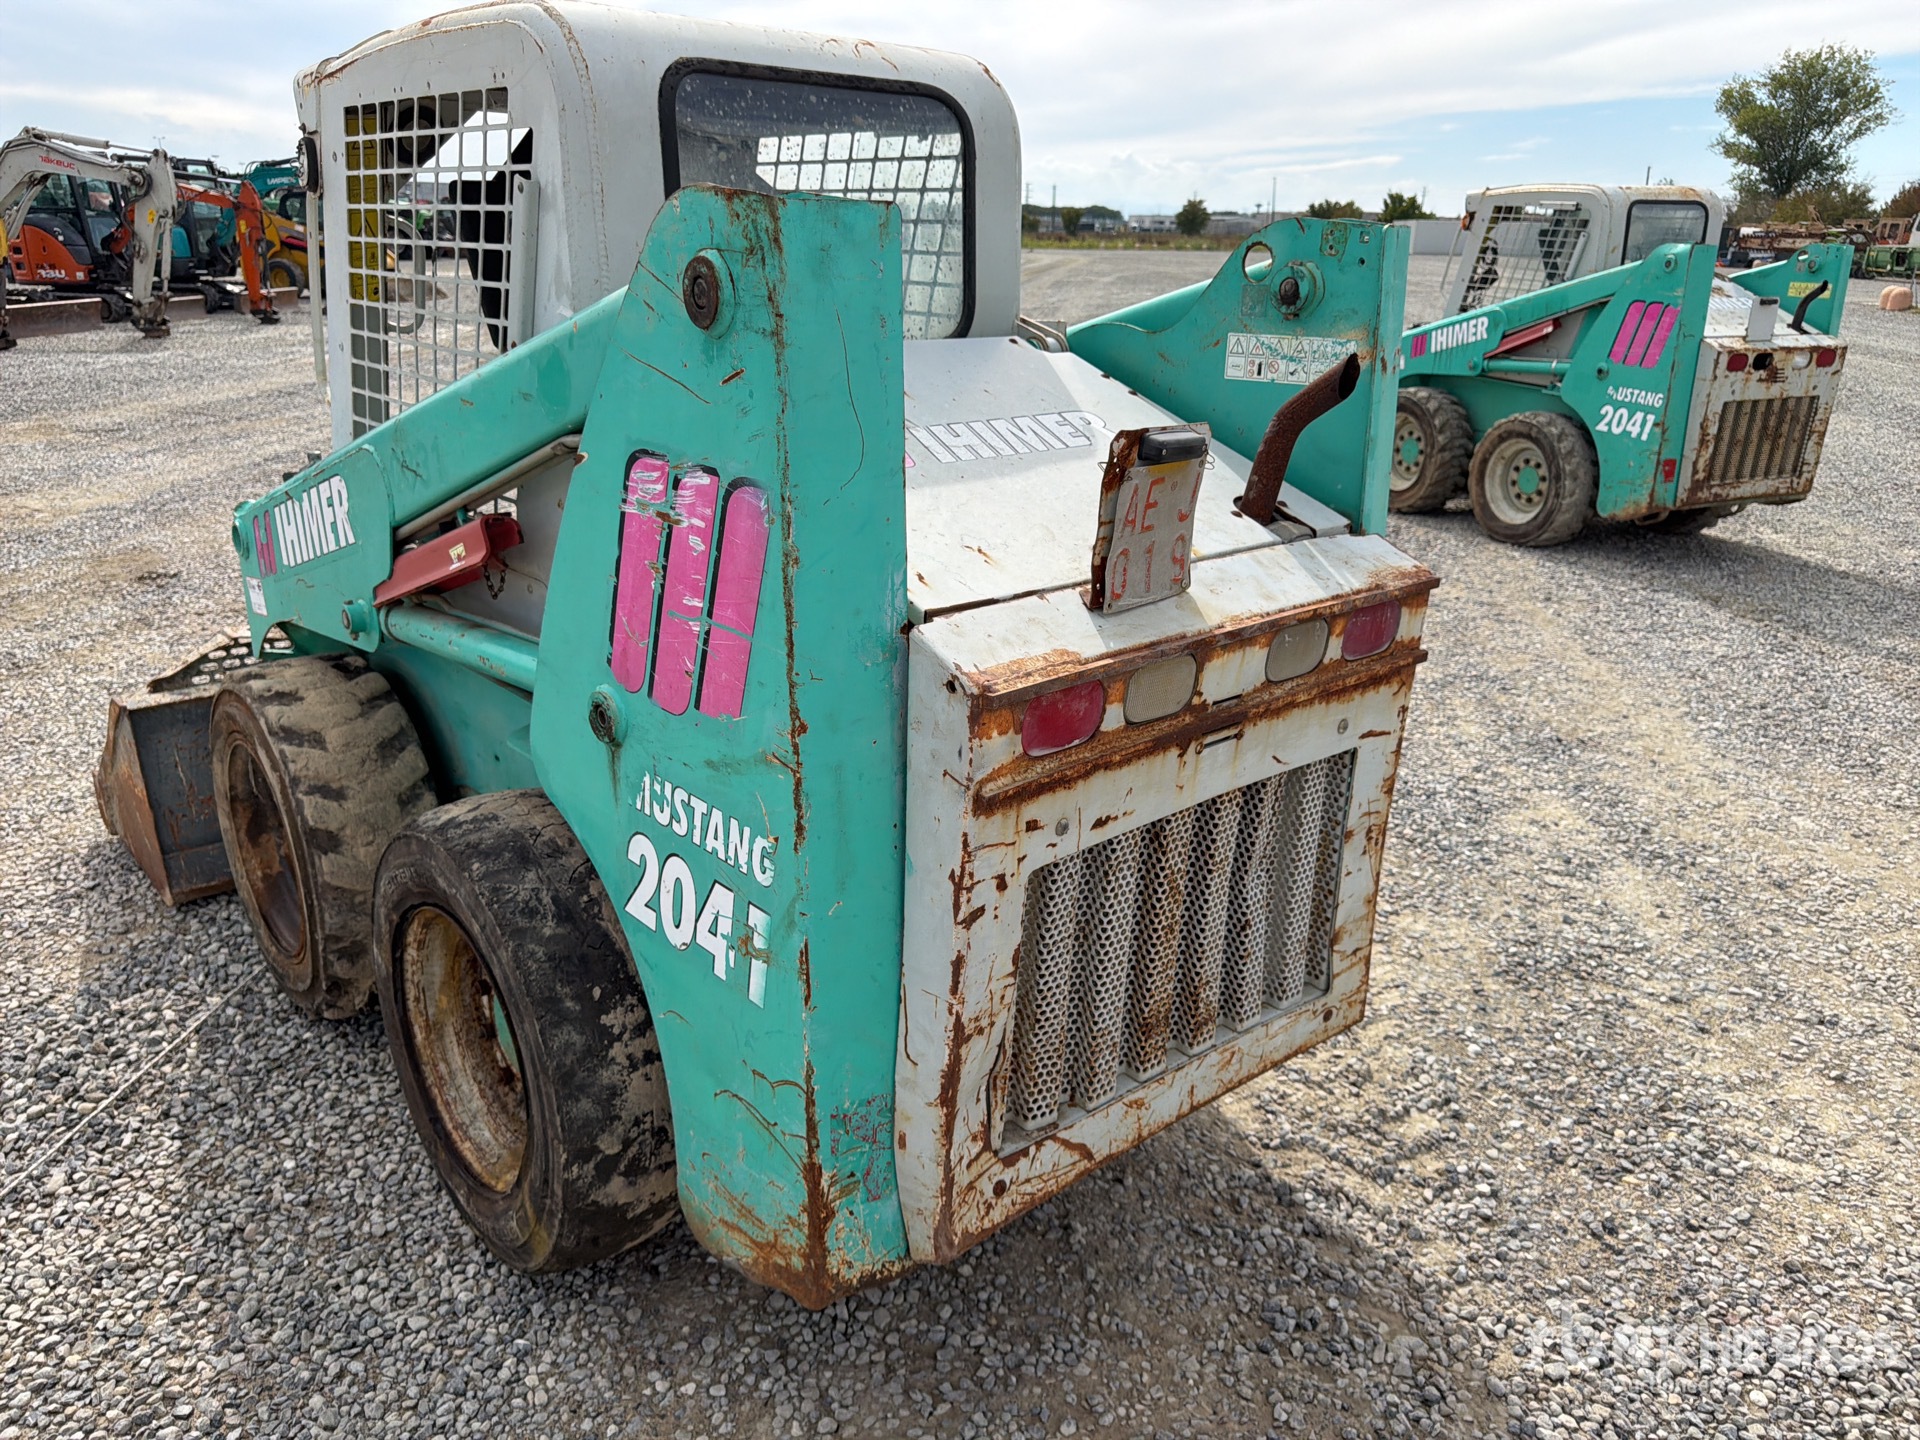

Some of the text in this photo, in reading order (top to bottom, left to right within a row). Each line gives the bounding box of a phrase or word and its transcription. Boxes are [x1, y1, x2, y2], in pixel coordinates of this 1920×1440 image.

[1430, 316, 1490, 354] IHIMER
[1595, 404, 1656, 442] 2041
[273, 473, 356, 569] IHIMER
[624, 832, 771, 1010] 2041
